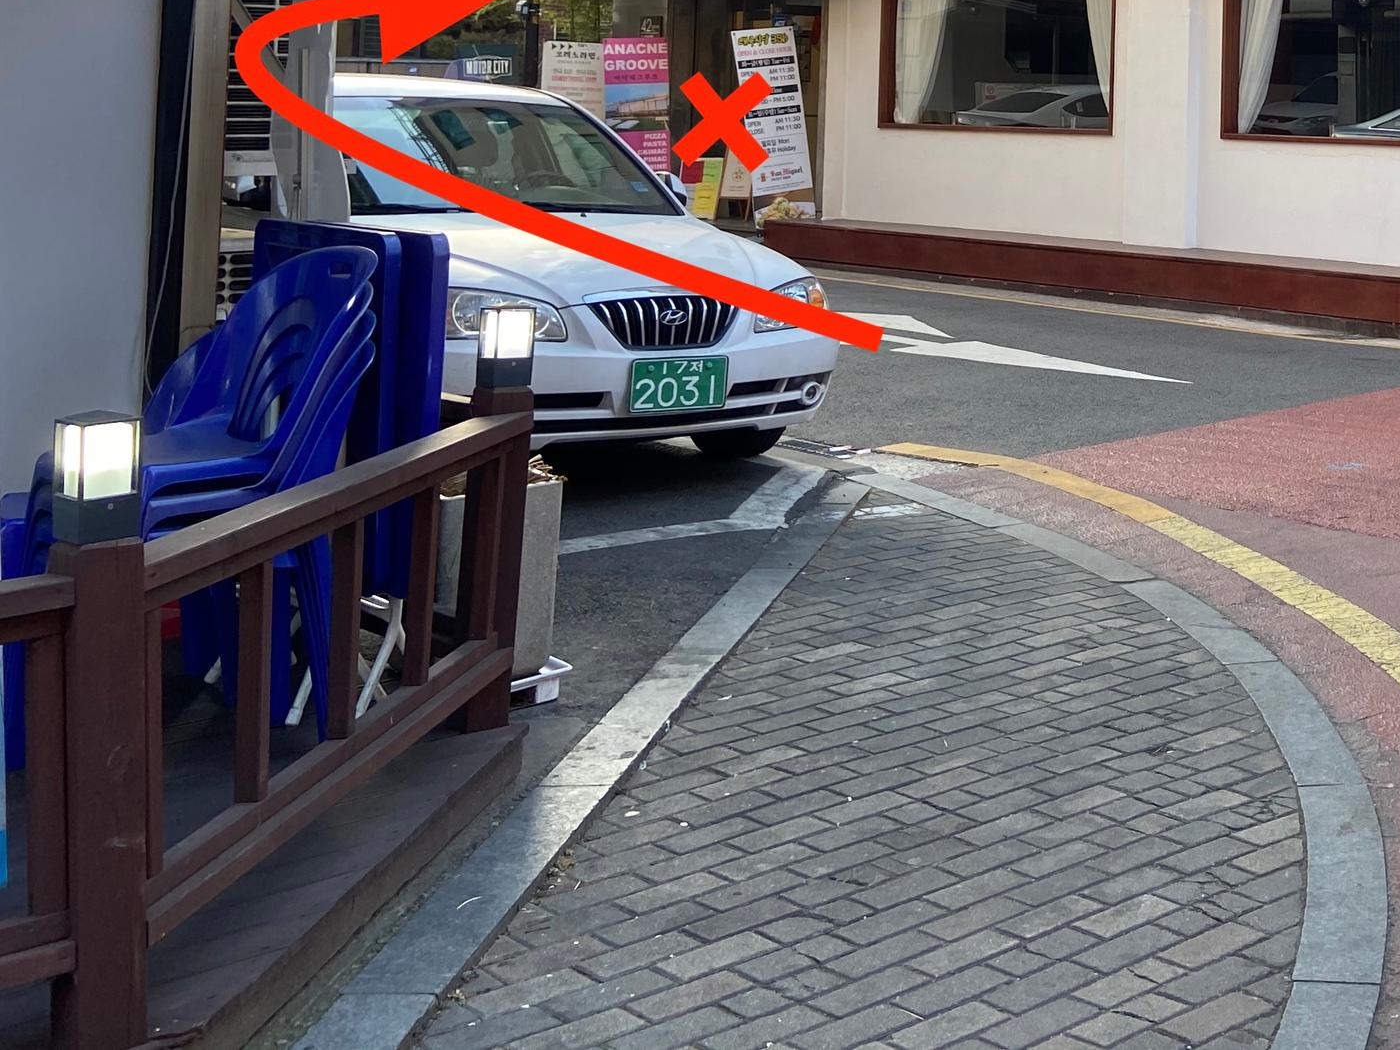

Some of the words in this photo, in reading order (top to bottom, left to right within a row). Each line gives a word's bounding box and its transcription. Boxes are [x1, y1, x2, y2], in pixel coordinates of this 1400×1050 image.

[641, 18, 652, 31] 42
[604, 43, 668, 54] ANACNE
[466, 60, 492, 74] MOTOR
[493, 60, 509, 74] CITY
[604, 59, 669, 71] GROOVE
[662, 360, 704, 375] 17저
[633, 375, 716, 409] 2031
